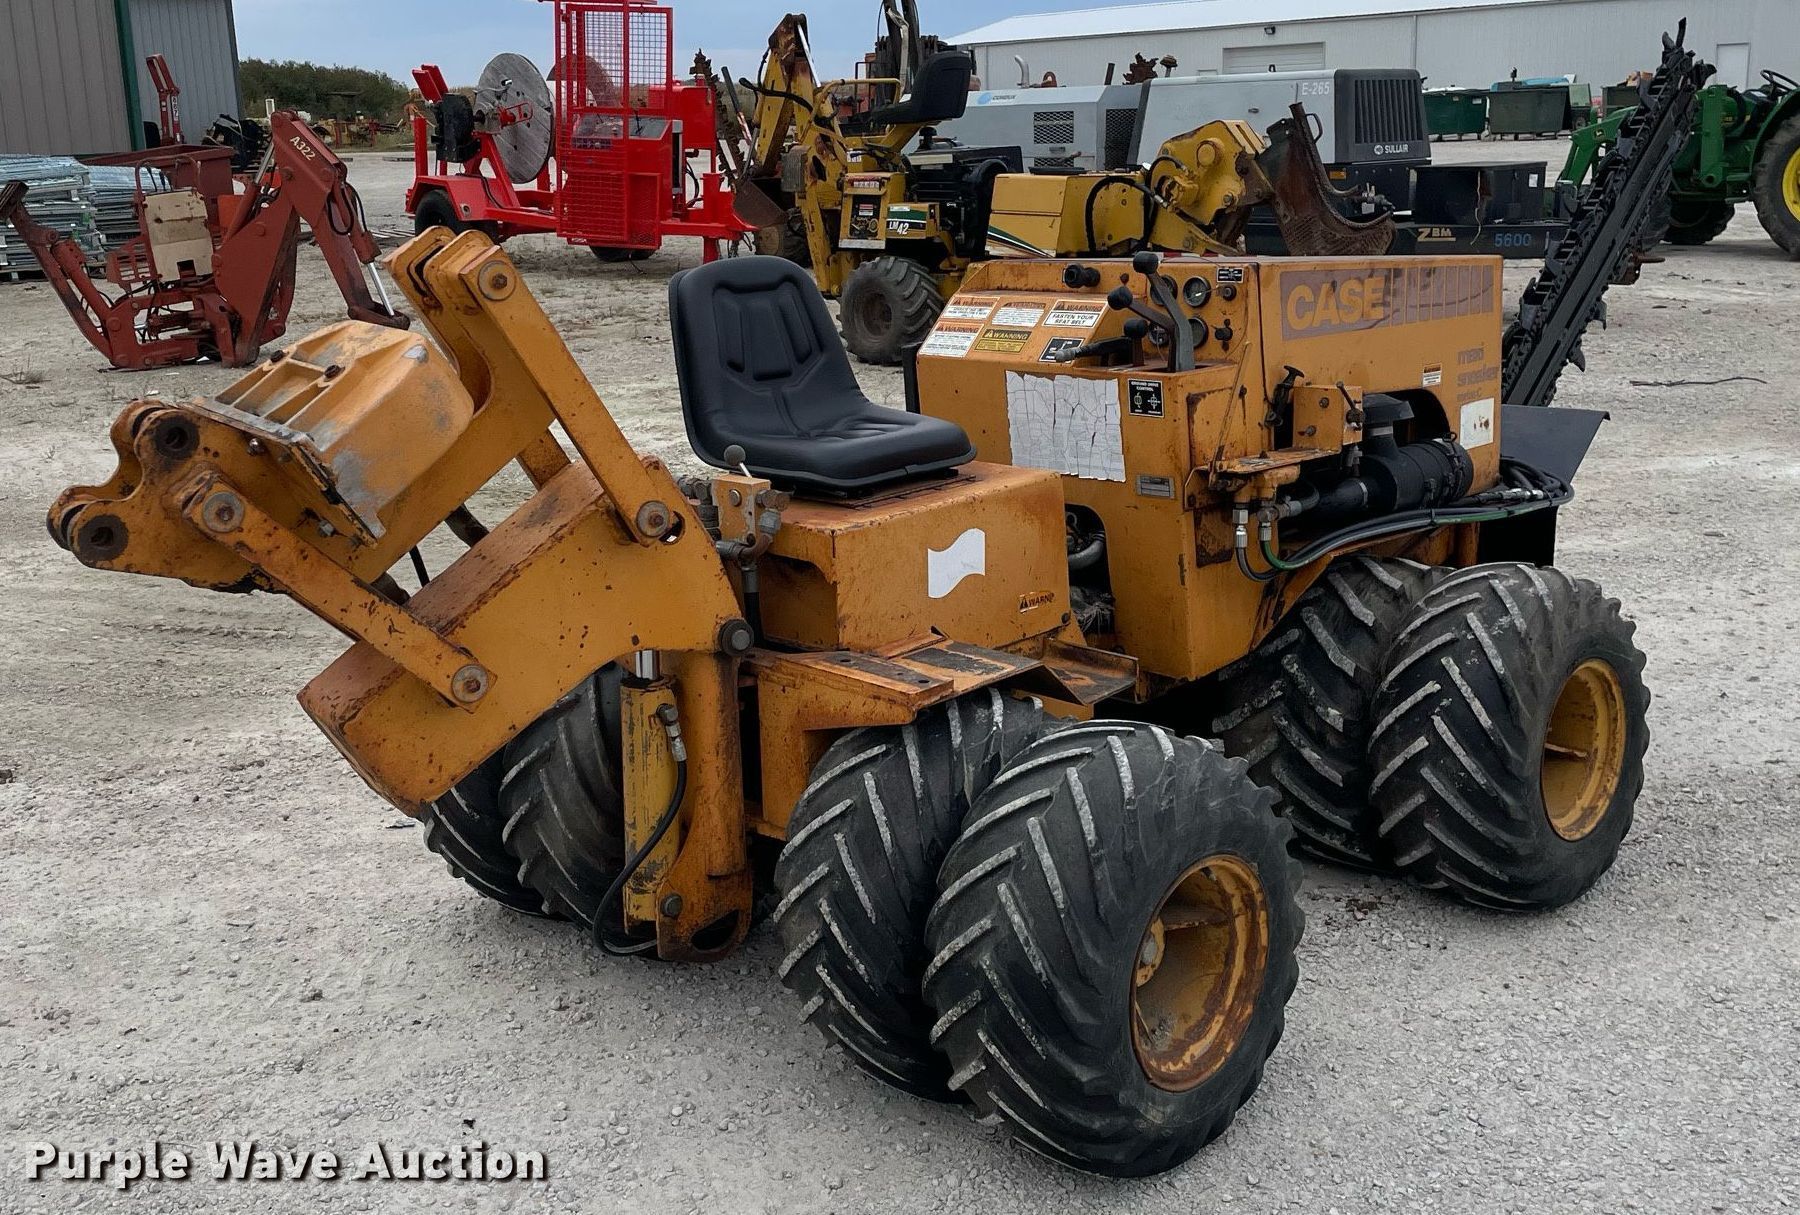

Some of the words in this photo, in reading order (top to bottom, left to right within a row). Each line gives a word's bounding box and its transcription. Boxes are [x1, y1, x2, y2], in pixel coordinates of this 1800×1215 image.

[1301, 81, 1330, 96] E-265
[290, 136, 316, 161] A322
[1384, 143, 1409, 154] SULLAIR
[1494, 233, 1532, 247] 5600
[1287, 276, 1385, 331] CASE
